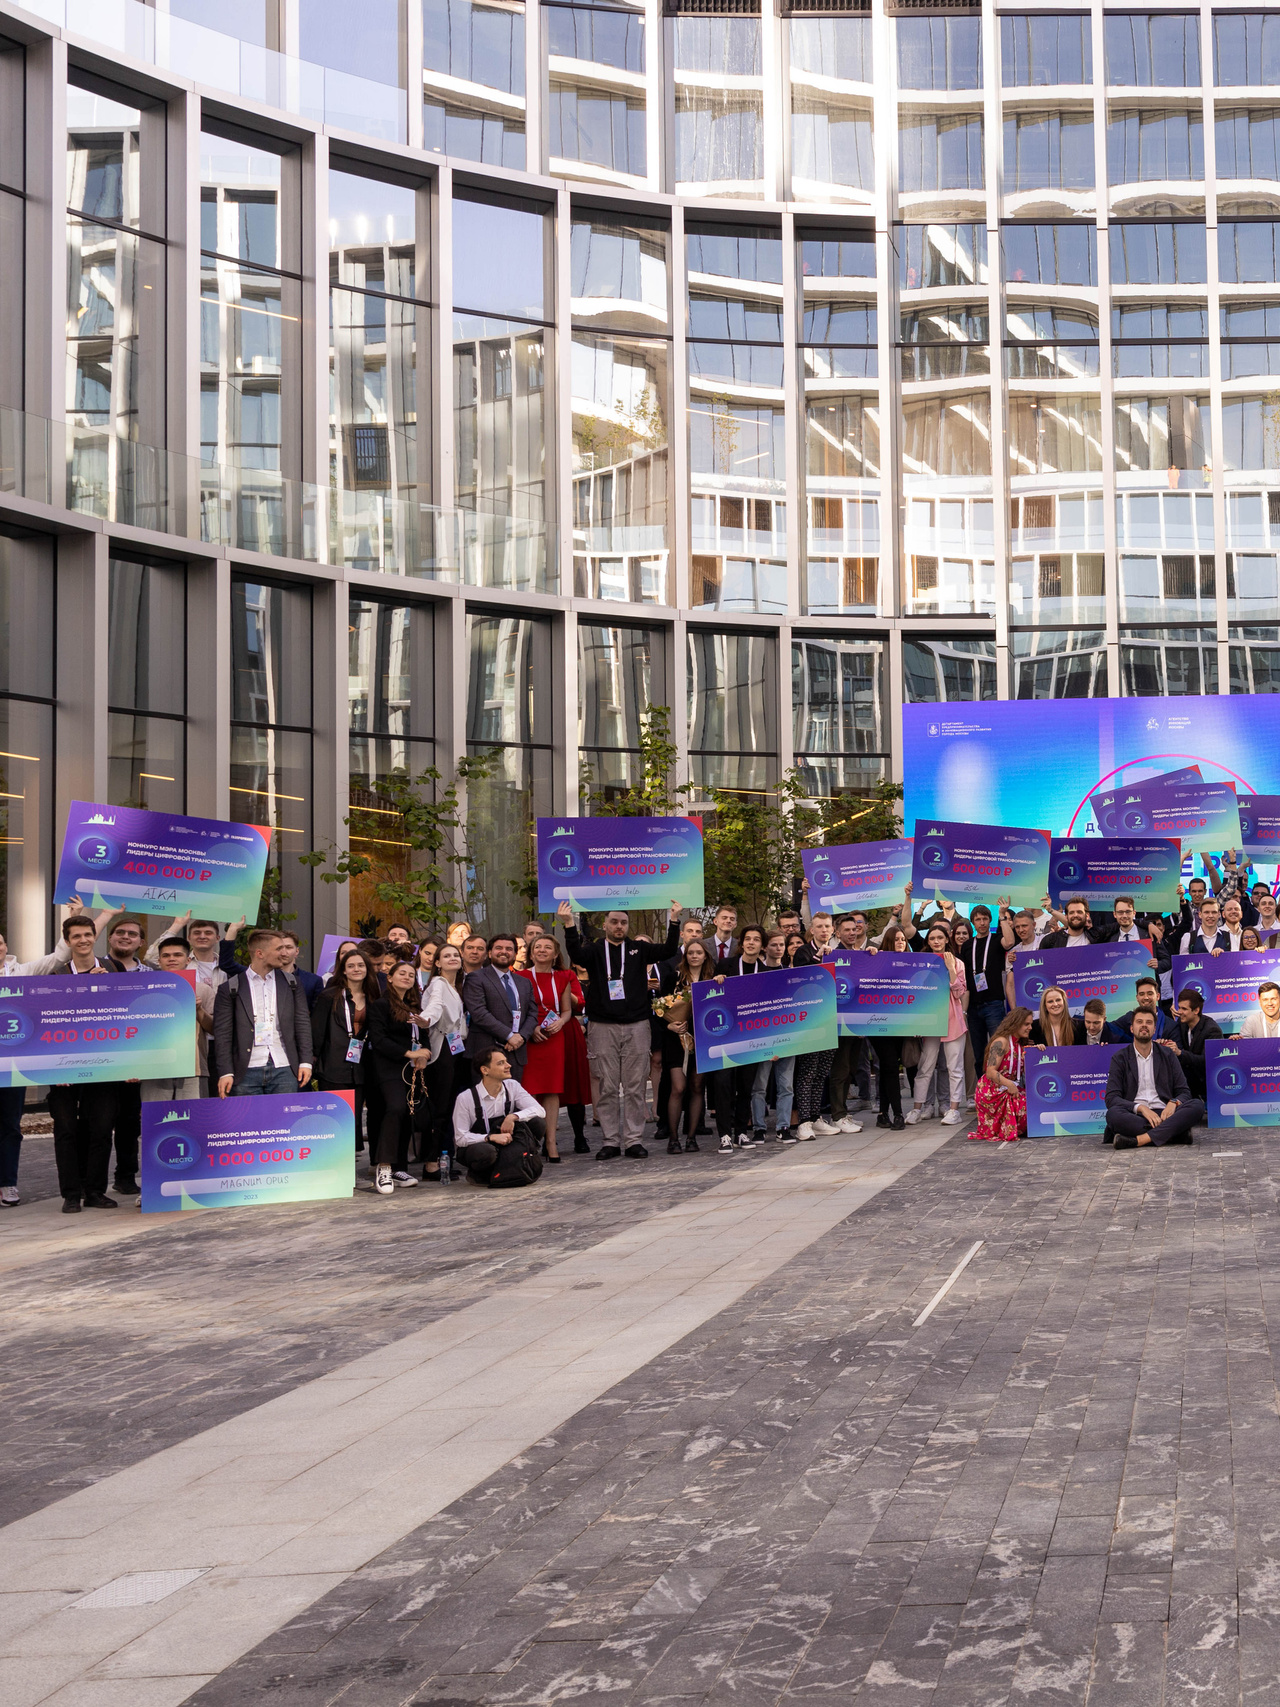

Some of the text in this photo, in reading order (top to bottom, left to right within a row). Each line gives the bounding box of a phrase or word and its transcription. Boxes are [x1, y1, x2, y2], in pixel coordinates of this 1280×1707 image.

[94, 845, 107, 857] 3
[127, 841, 158, 850] КОНКУРС
[178, 848, 206, 856] МОСКВЫ
[87, 857, 111, 865] МЕСТО
[126, 849, 247, 868] ЛИДЕРЫ ЦИФРОВОЙ ТРАНСФОРМАЦИИ
[565, 854, 571, 865] 1
[123, 860, 212, 882] 400 000 ₽
[589, 863, 670, 875] 1 000 000 ₽
[953, 863, 1012, 877] 600 000 ₽
[72, 1014, 112, 1023] ЦИФРОВОЙ
[113, 1013, 175, 1021] ТРАНСФОРМАЦИИ
[739, 1011, 807, 1032] 1 000 000 ₽
[7, 1019, 19, 1032] 3
[41, 1027, 138, 1043] 400 000 ₽
[1252, 1083, 1257, 1093] 1
[207, 1133, 335, 1148] ЛИДЕРЫ ЦИФРОВОЙ ТРАНСФОРМАЦИИ
[177, 1143, 184, 1156] 1
[208, 1147, 311, 1166] 1 000 000 ₽
[220, 1175, 290, 1189] MAGNUM OPUS
